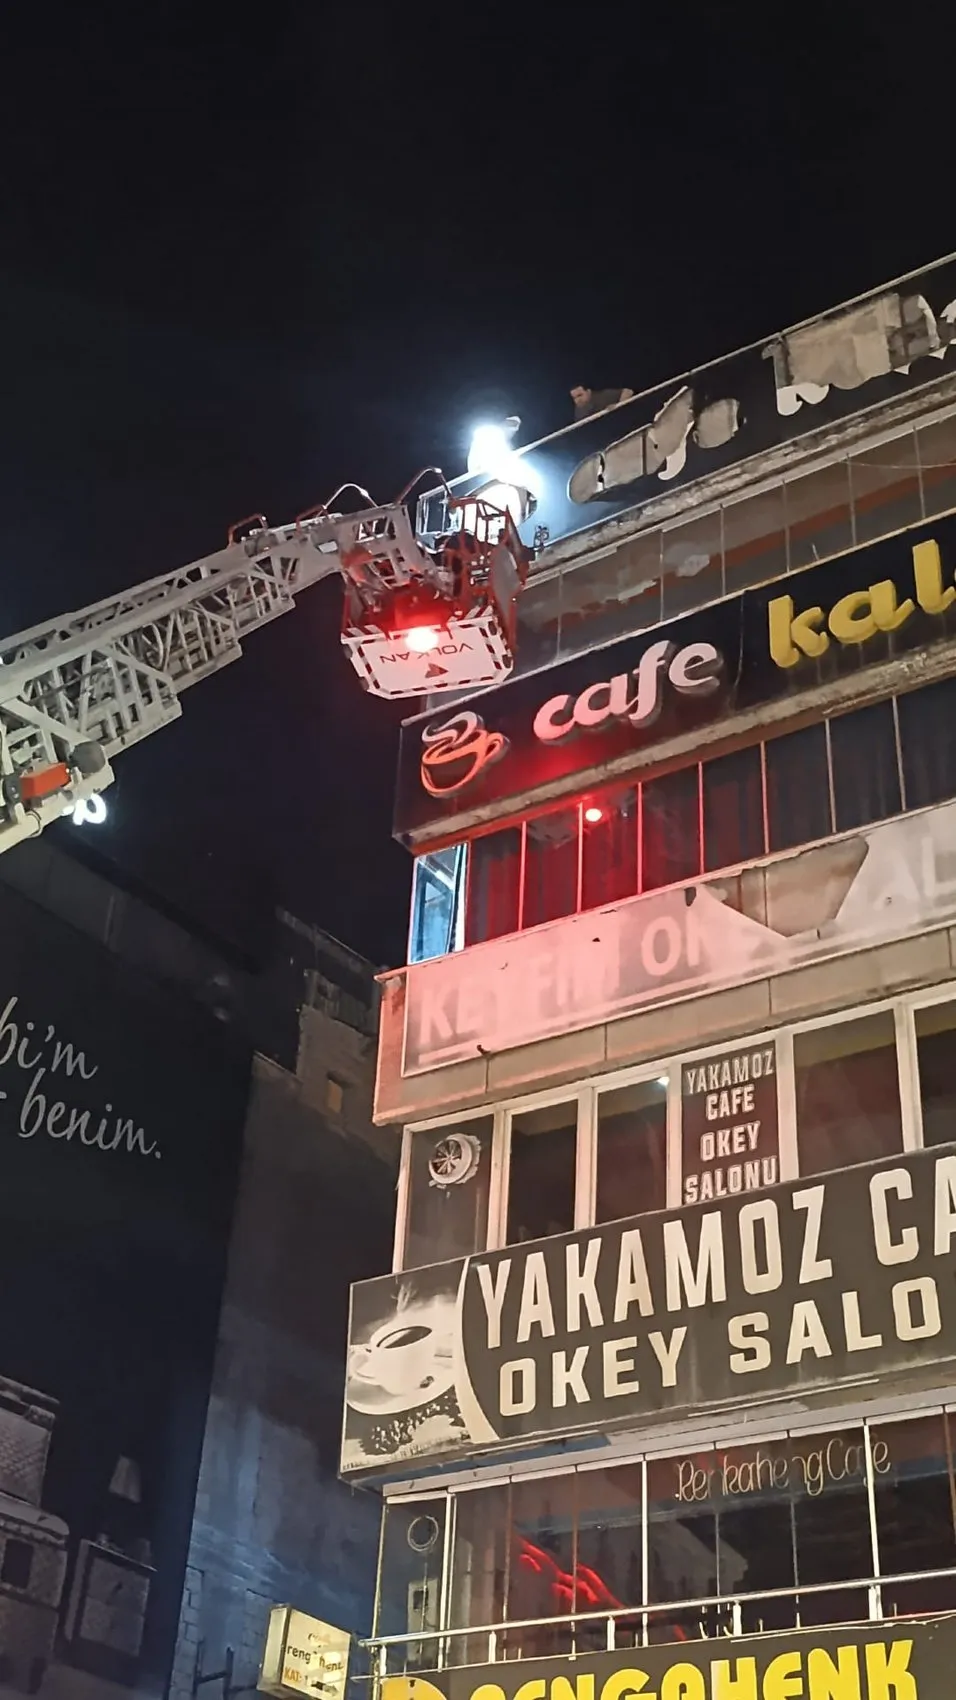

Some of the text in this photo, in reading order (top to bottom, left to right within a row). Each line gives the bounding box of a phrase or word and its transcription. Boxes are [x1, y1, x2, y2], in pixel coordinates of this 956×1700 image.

[379, 641, 474, 664] VOLKAN
[533, 538, 956, 744] cafe kal
[685, 1048, 775, 1096] YAKAMOZ
[17, 1066, 163, 1160] benim.
[705, 1083, 756, 1121] CAFE
[700, 1120, 761, 1162] OKEY
[684, 1155, 778, 1205] SALONU
[477, 1184, 833, 1349] YAKAMOZ
[499, 1276, 942, 1417] OKEY SALO
[826, 1433, 892, 1488] Cae
